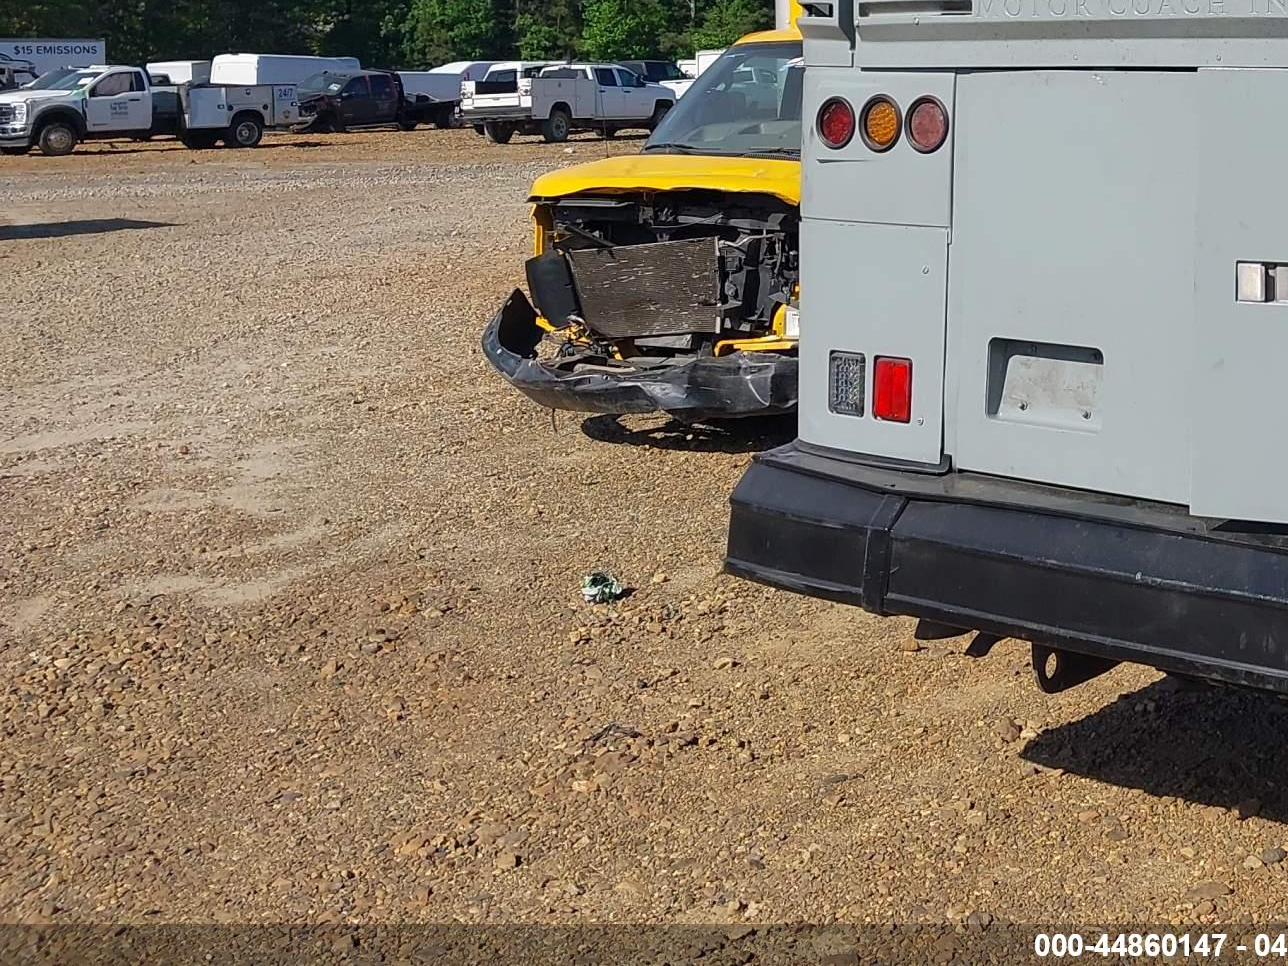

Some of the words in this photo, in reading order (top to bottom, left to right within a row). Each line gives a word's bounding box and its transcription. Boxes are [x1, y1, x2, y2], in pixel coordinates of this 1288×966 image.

[14, 45, 33, 55] $15
[36, 45, 97, 55] EMISSIONS
[278, 88, 294, 98] 24/7
